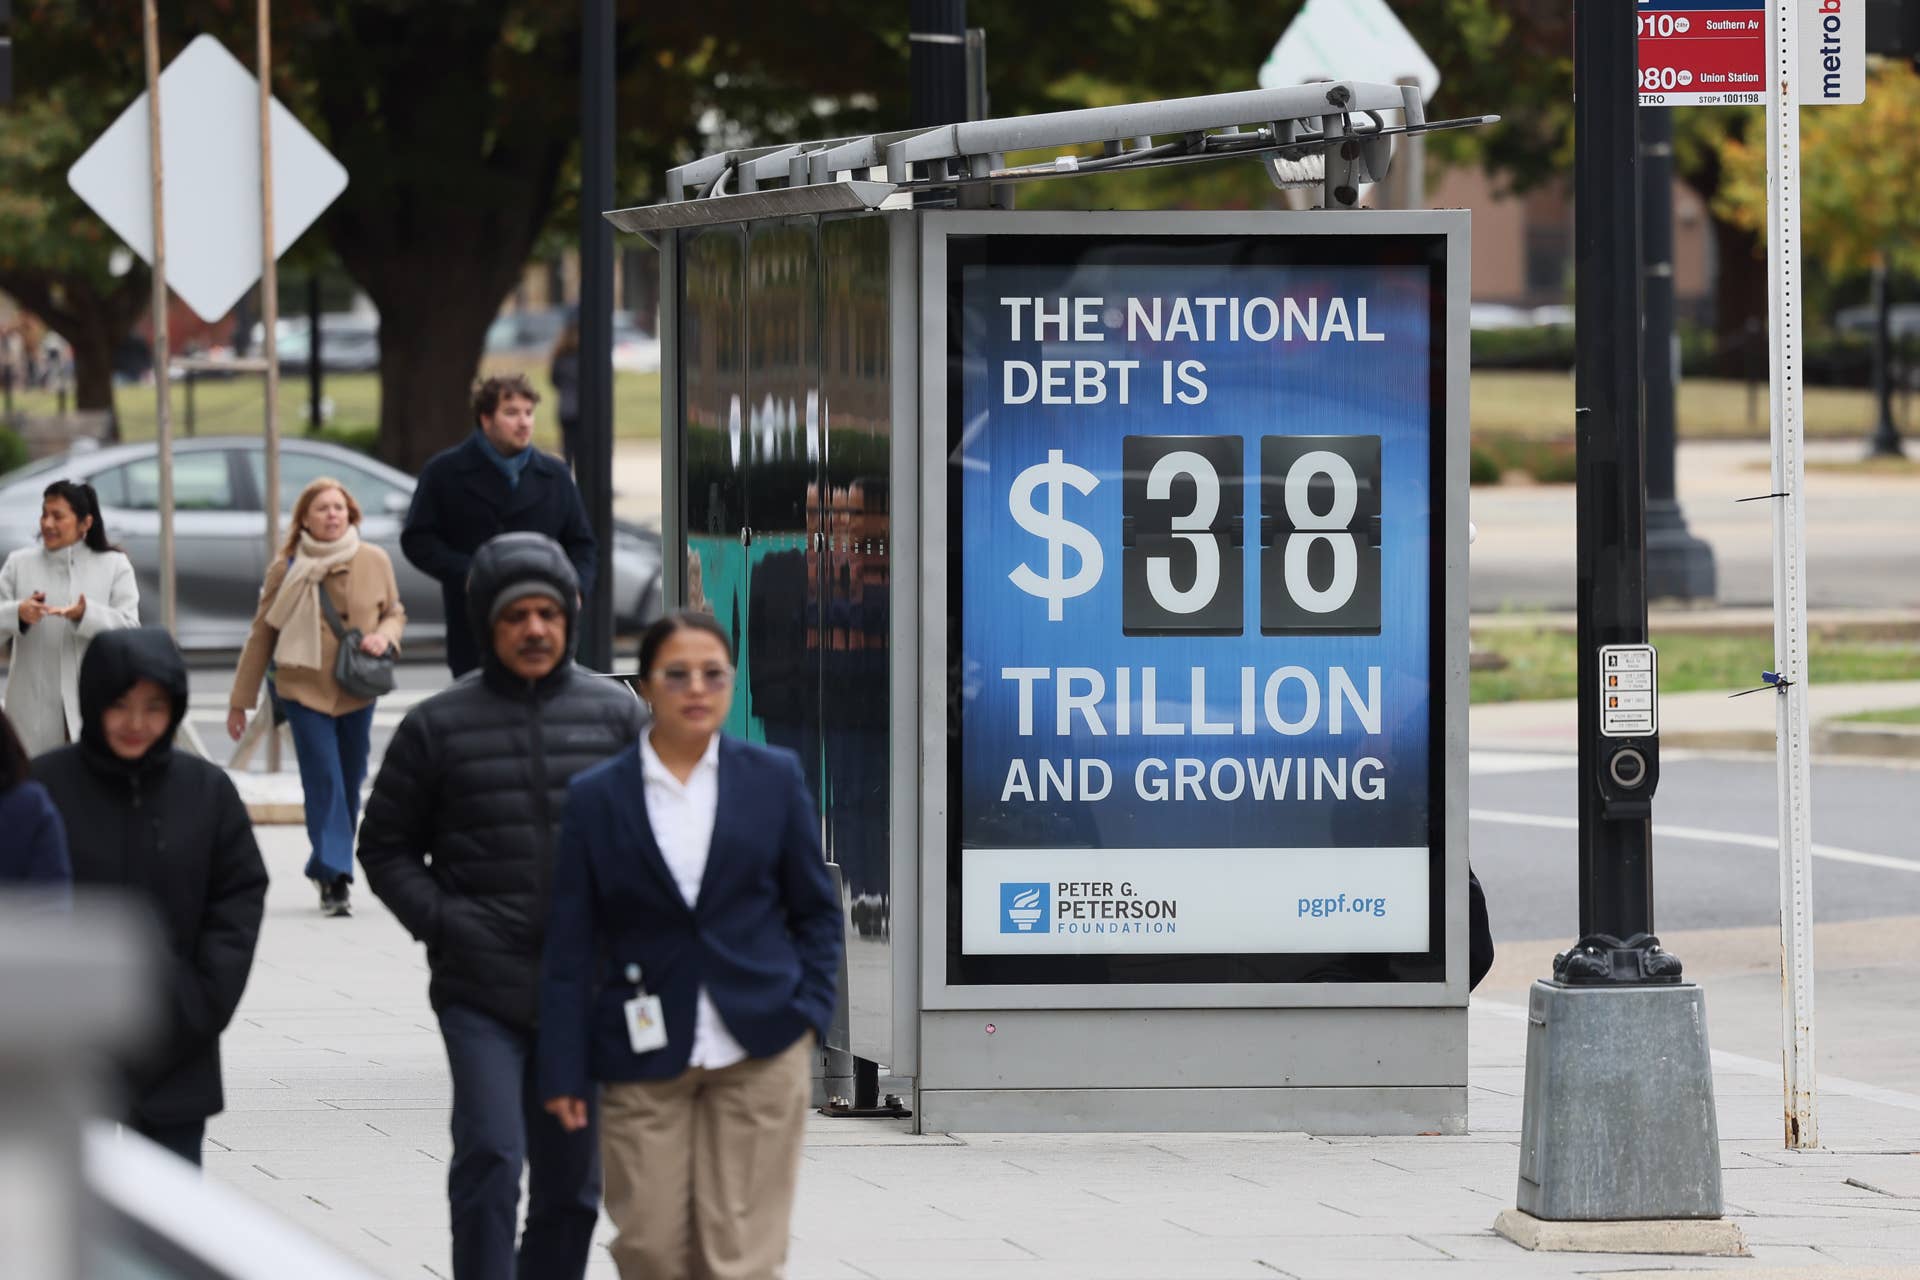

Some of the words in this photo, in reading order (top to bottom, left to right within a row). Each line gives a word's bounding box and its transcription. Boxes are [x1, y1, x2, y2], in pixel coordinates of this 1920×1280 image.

[1706, 20, 1746, 30] Southern
[1747, 20, 1759, 29] Av
[1700, 73, 1726, 82] Union
[1728, 72, 1759, 82] Station
[1722, 93, 1759, 103] 1001198
[1000, 297, 1104, 342] THE
[1127, 297, 1385, 342] NATIONAL
[1003, 360, 1139, 405] DEBT
[1163, 359, 1208, 405] IS
[1001, 665, 1382, 736] TRILLION
[1001, 758, 1113, 802] AND
[1134, 757, 1386, 801] GROWING
[1058, 882, 1113, 897] PETER
[1120, 881, 1138, 897] G.
[1058, 900, 1177, 919] PETERSON
[1298, 893, 1386, 918] pgpf.org
[1058, 922, 1177, 934] FOUNDATION
